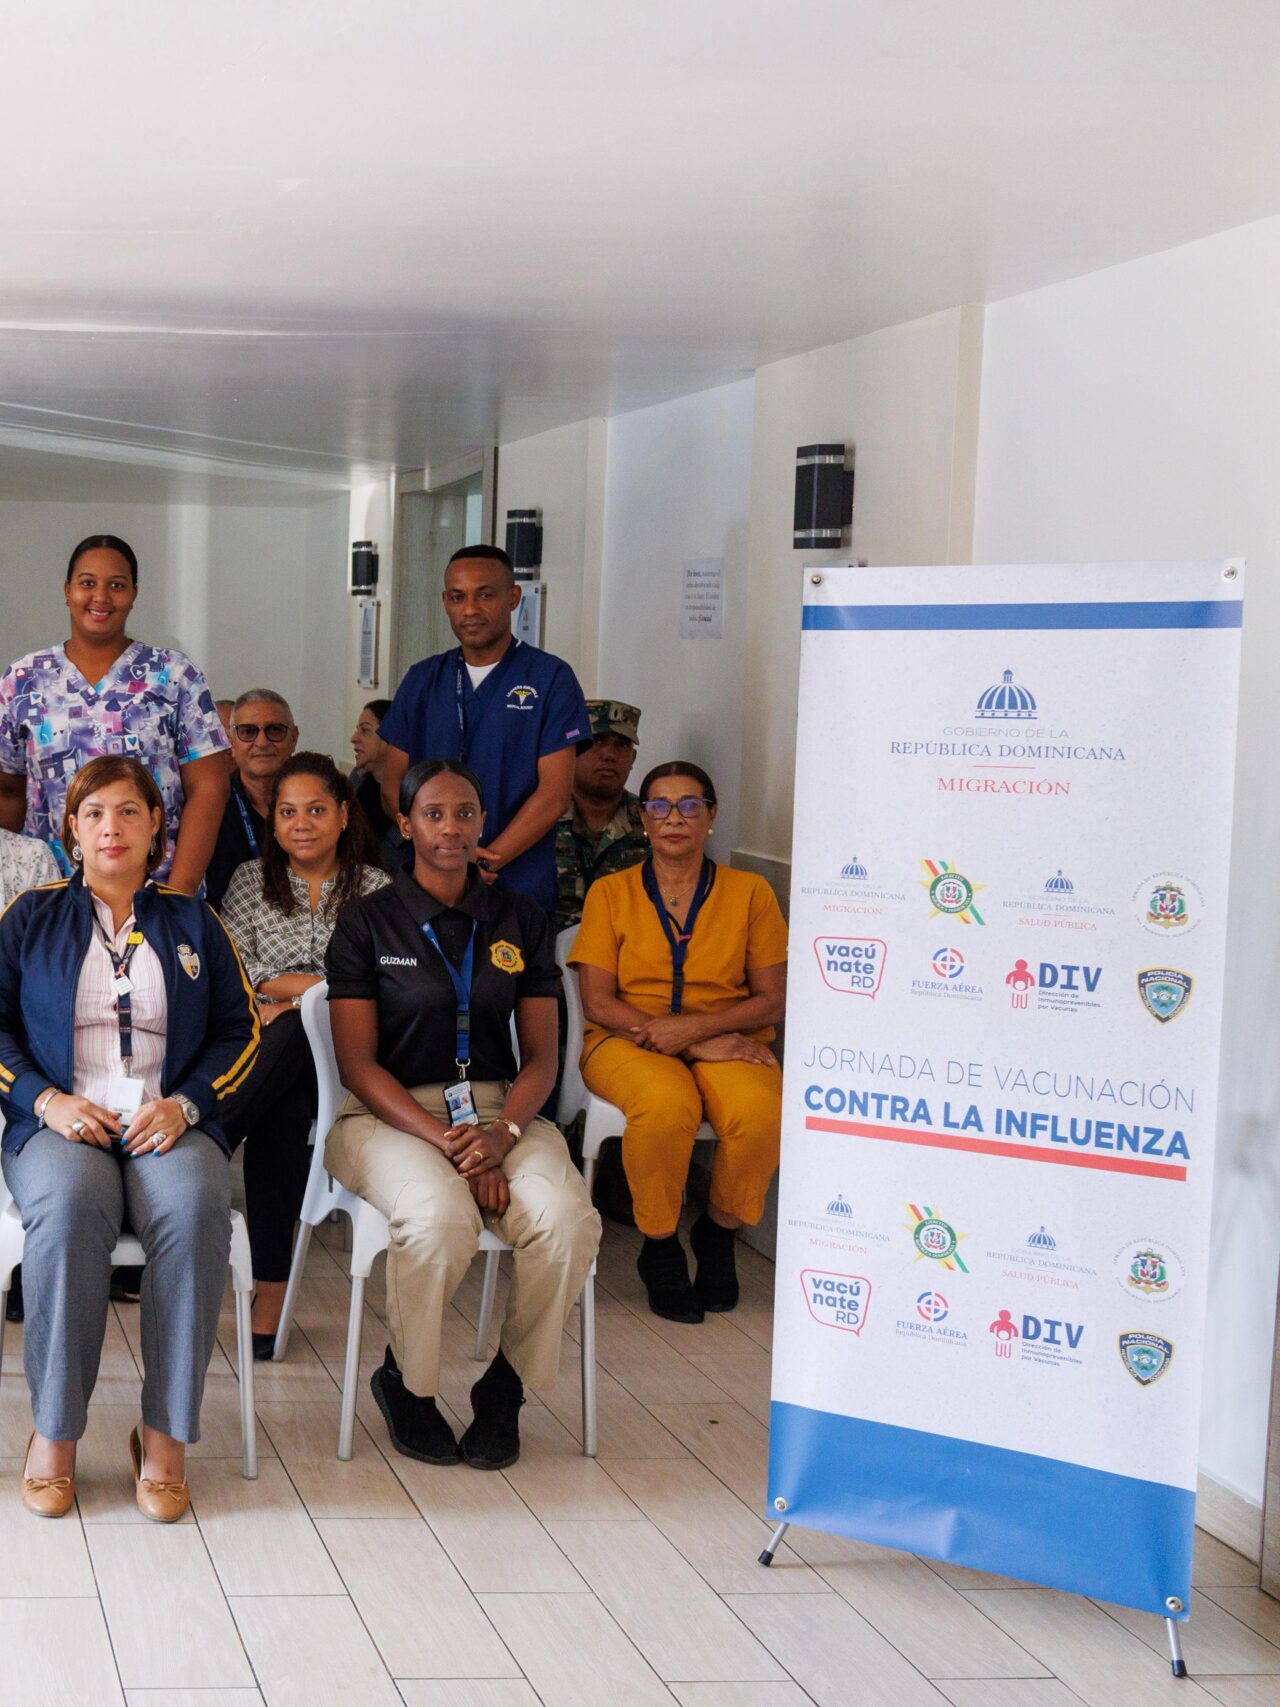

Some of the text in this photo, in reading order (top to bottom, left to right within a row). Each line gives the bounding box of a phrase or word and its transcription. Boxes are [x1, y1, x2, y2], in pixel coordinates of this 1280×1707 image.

[942, 726, 1069, 739] GOBIERNO DE LA
[890, 740, 1126, 761] REPÚBLICA DOMINICANA
[937, 777, 1071, 795] MIGRACIÓN
[849, 889, 906, 902] DOMINICANA
[1055, 904, 1116, 916] DOMINICANA
[1018, 917, 1051, 928] SALUD
[825, 943, 876, 960] vacú
[379, 955, 418, 967] GUZMAN
[826, 959, 874, 975] nate
[851, 975, 874, 989] RD
[911, 979, 949, 991] FUERZA
[1038, 961, 1103, 993] DIV
[803, 1045, 1196, 1113] JORNADA DE VACUNACIÓN
[804, 1084, 1192, 1160] CONTRA LA INFLUENZA
[1001, 1269, 1034, 1282] SALUD
[1038, 1259, 1098, 1276] DOMINICANA
[811, 1276, 861, 1297] vacú
[812, 1291, 860, 1312] nate
[835, 1310, 859, 1326] RD
[895, 1320, 934, 1335] FUERZA
[1022, 1314, 1085, 1349] DIV
[1122, 1340, 1170, 1354] NACIONAL
